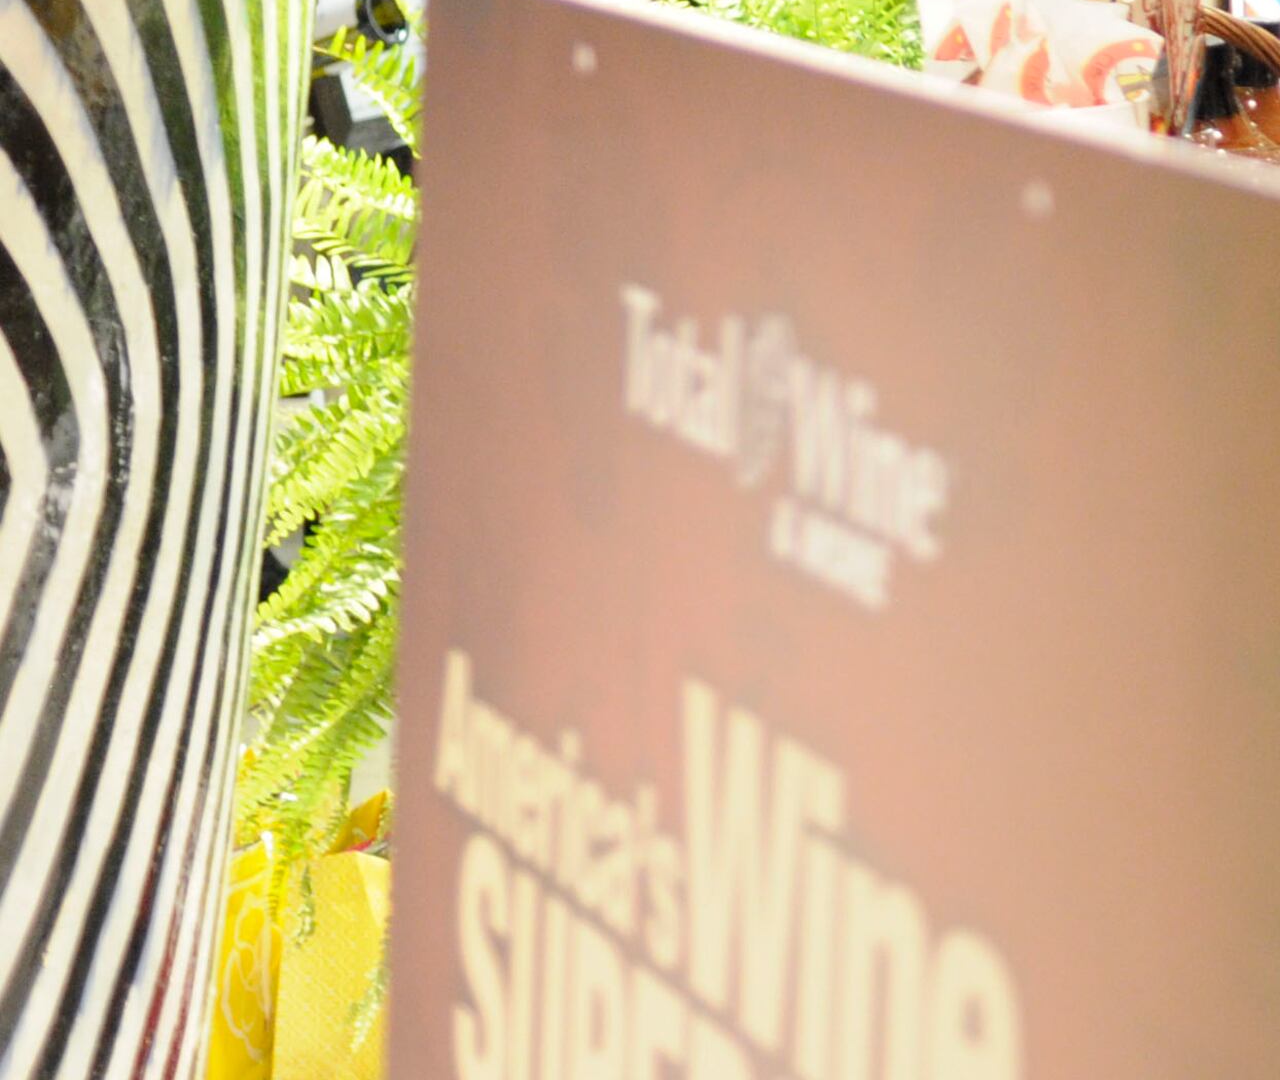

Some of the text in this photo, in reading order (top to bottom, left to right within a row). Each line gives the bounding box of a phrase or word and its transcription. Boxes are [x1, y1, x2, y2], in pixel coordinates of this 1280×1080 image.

[621, 284, 946, 560] Total Wine
[433, 648, 1022, 1080] America's Wine
